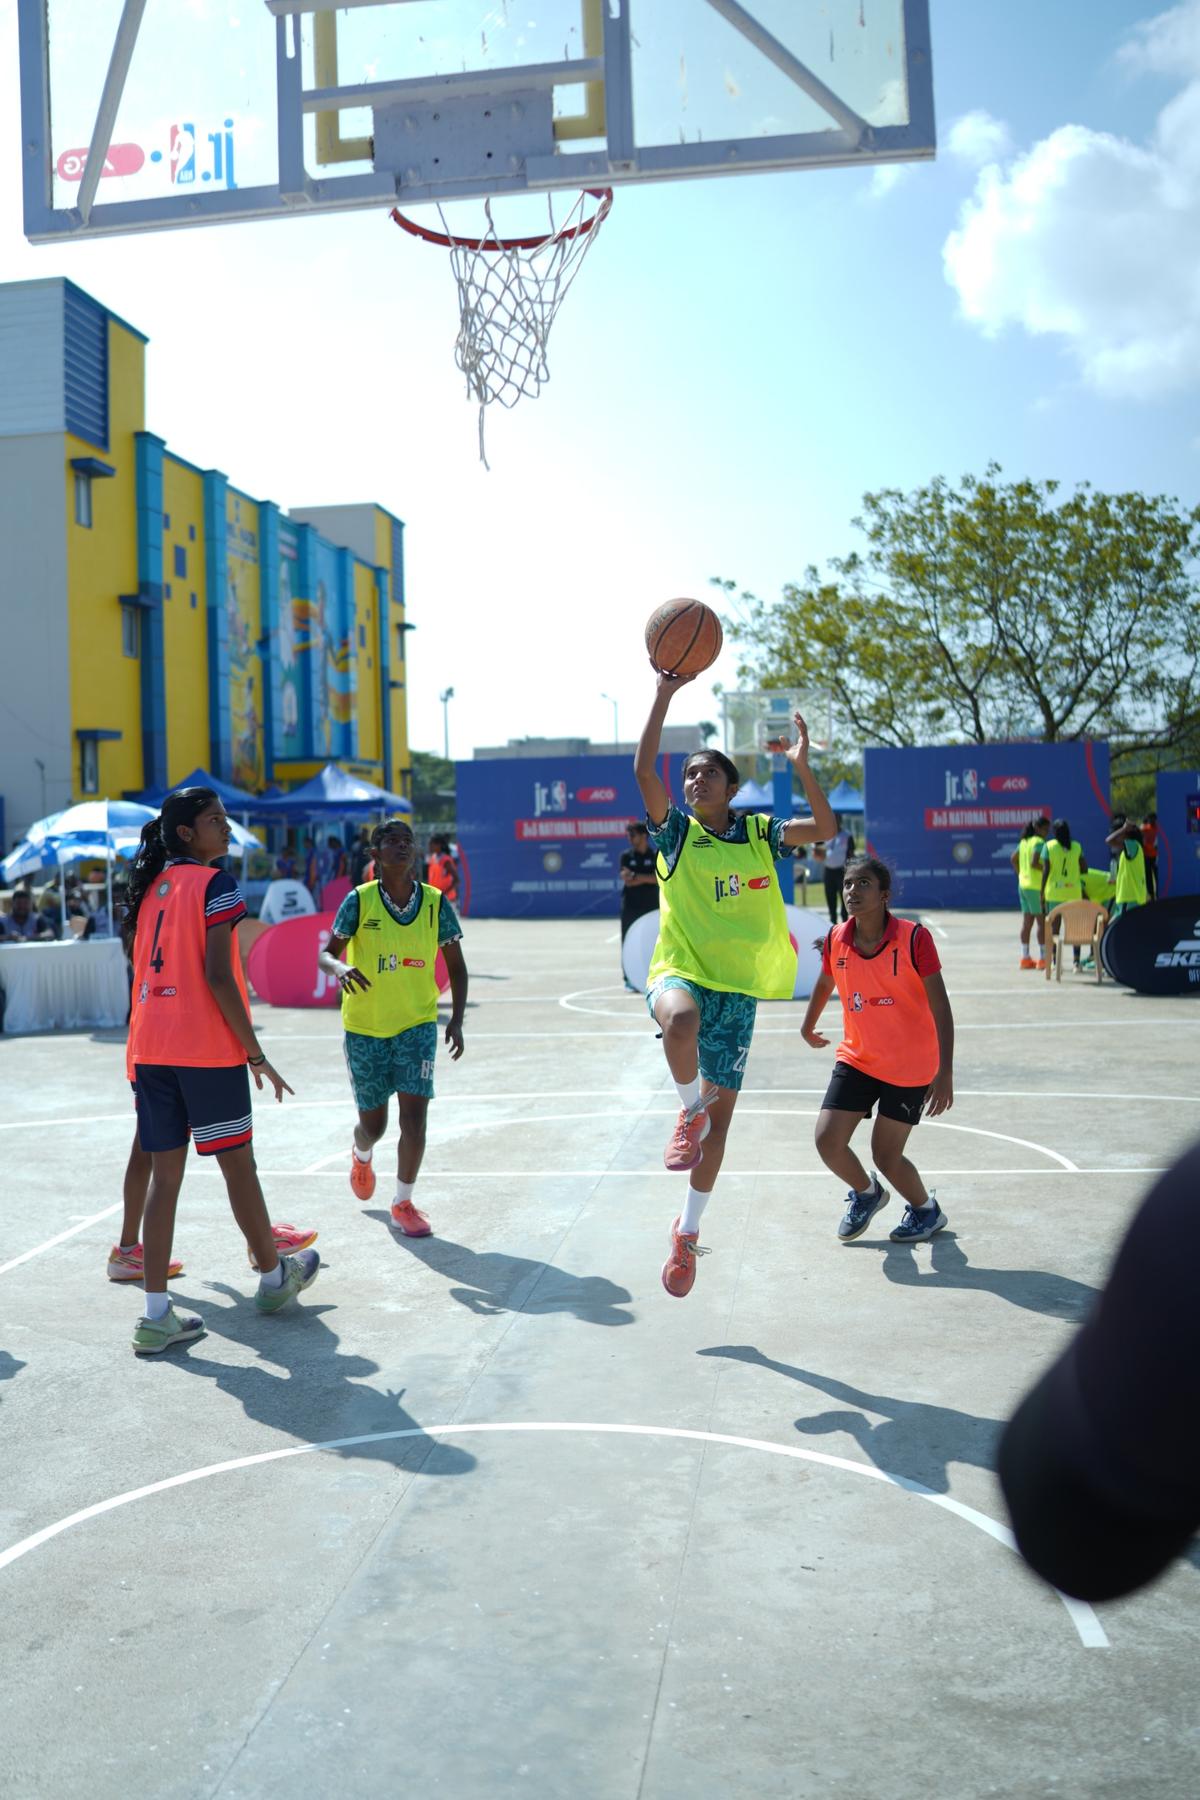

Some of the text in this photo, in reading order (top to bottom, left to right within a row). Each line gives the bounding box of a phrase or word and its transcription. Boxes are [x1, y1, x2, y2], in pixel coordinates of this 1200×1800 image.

[945, 770, 962, 806] jr.
[948, 810, 987, 826] NATIONAL
[149, 910, 165, 974] 4
[891, 947, 899, 977] 1
